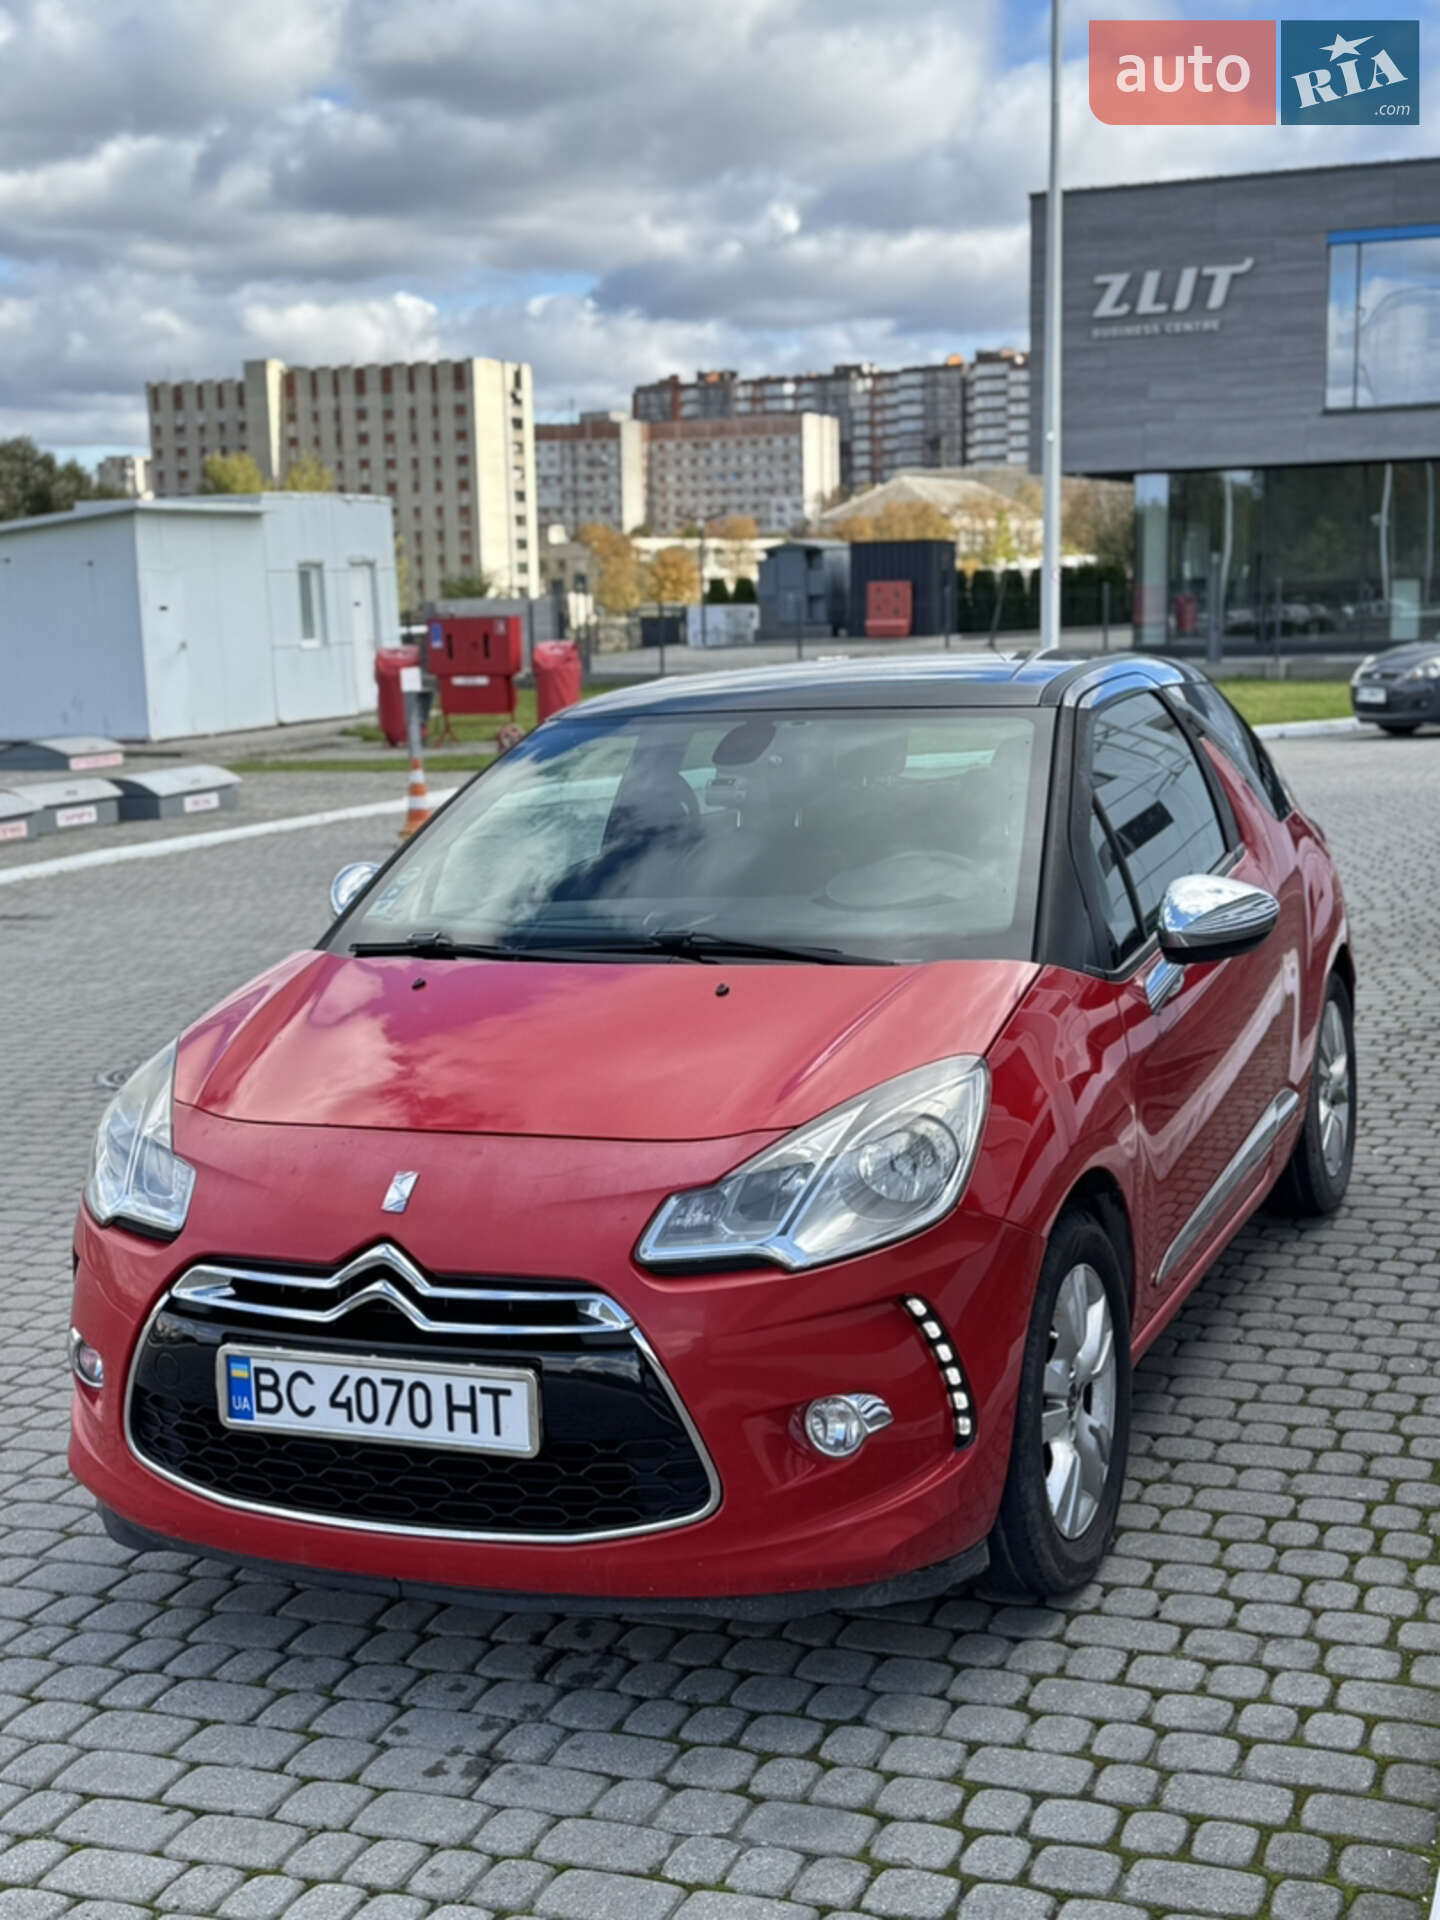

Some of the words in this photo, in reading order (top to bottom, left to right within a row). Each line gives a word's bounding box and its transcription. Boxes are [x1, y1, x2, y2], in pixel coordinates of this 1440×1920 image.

[1092, 257, 1254, 318] ZLIT
[232, 1395, 251, 1411] UA
[253, 1367, 316, 1418] BC
[329, 1374, 433, 1429] 4070
[445, 1383, 512, 1437] HT
